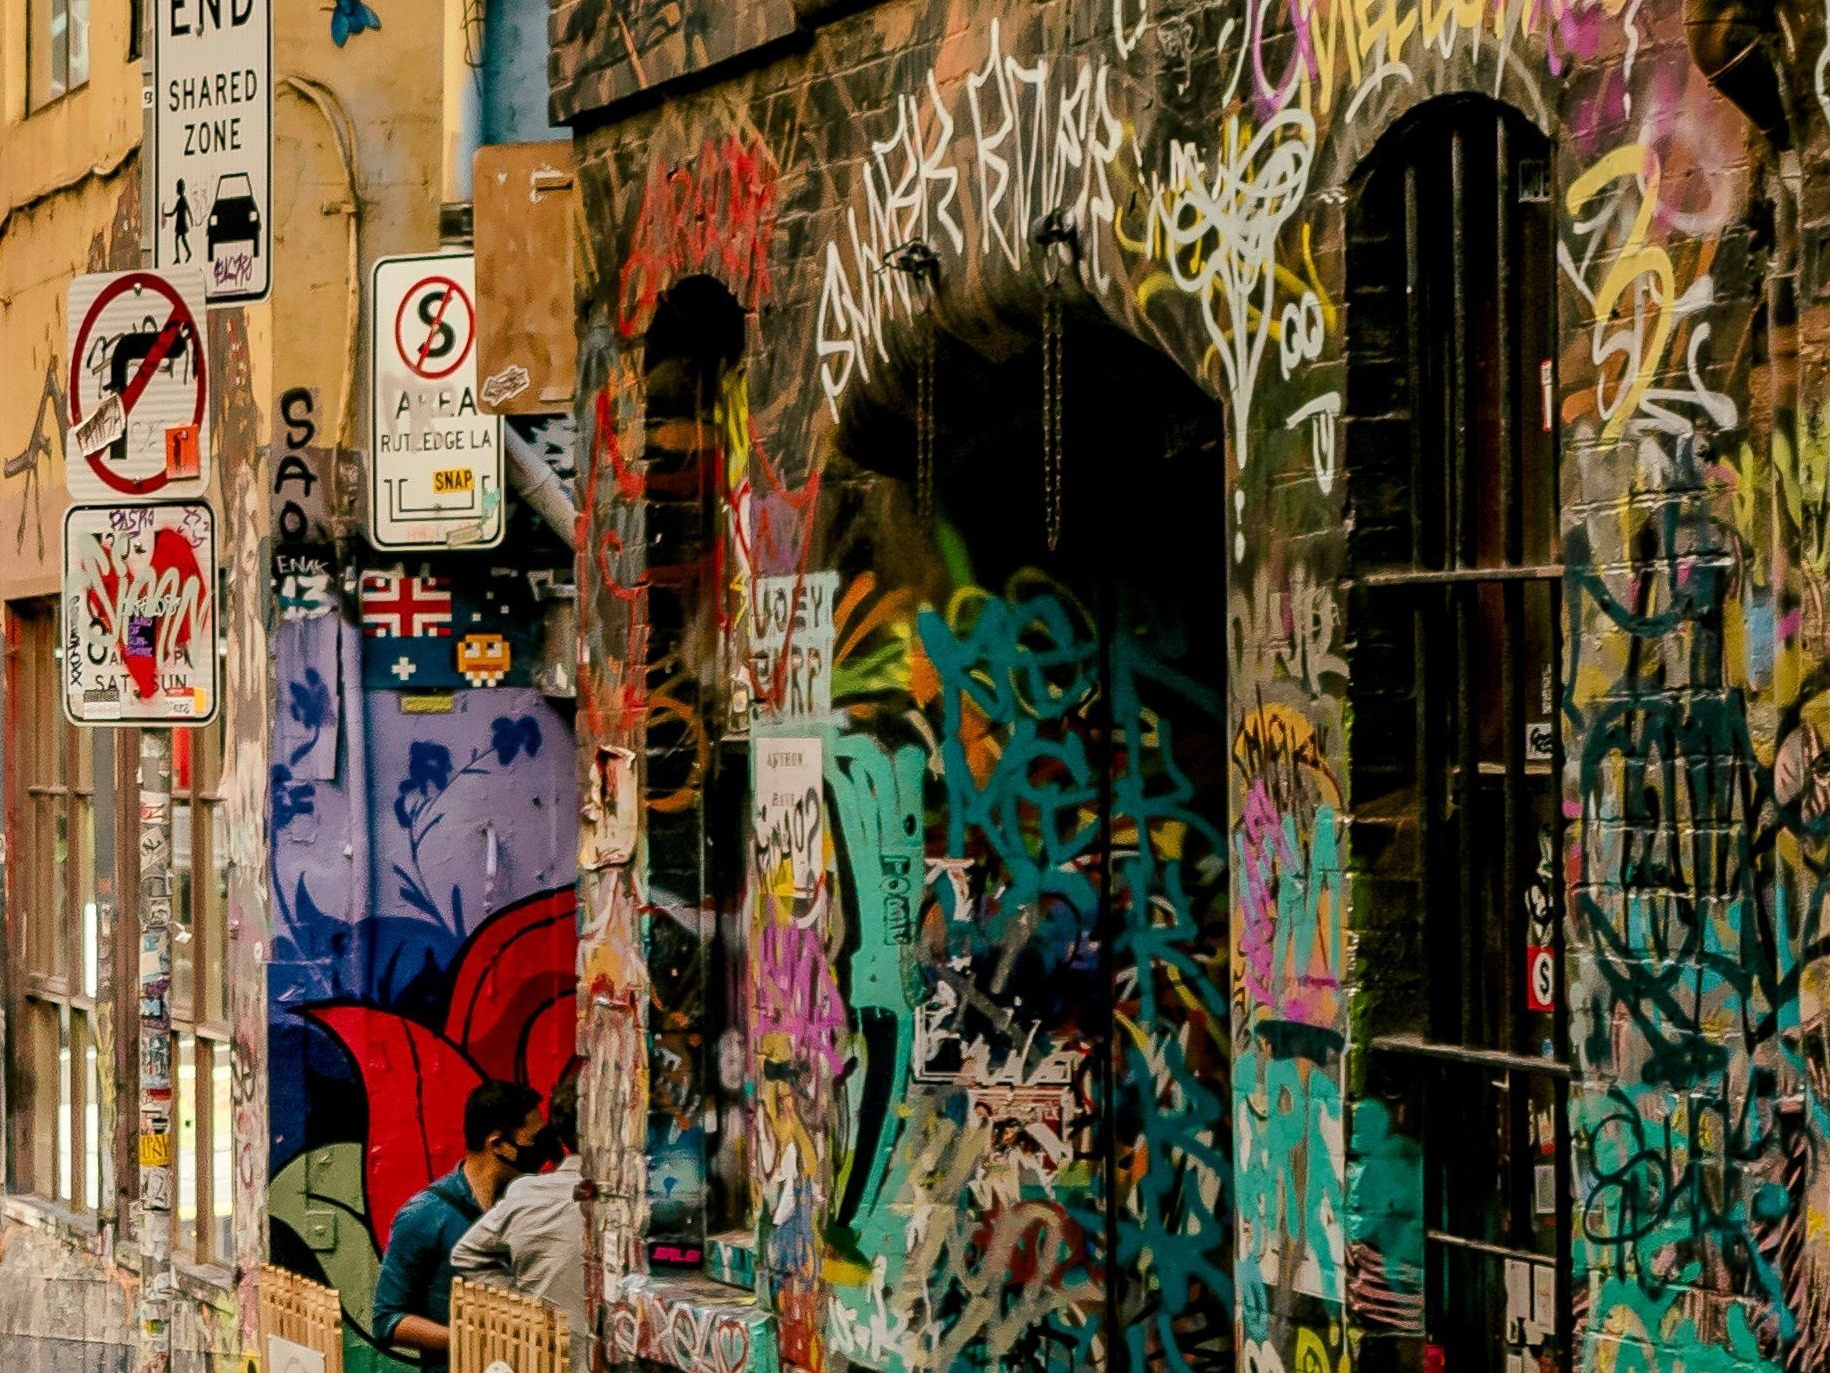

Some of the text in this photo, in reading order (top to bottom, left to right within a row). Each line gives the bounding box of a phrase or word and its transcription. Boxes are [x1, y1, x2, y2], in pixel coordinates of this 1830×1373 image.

[169, 69, 257, 112] SHARED
[183, 118, 241, 156] ZONE
[434, 470, 473, 493] SNAP
[95, 674, 130, 692] SAT
